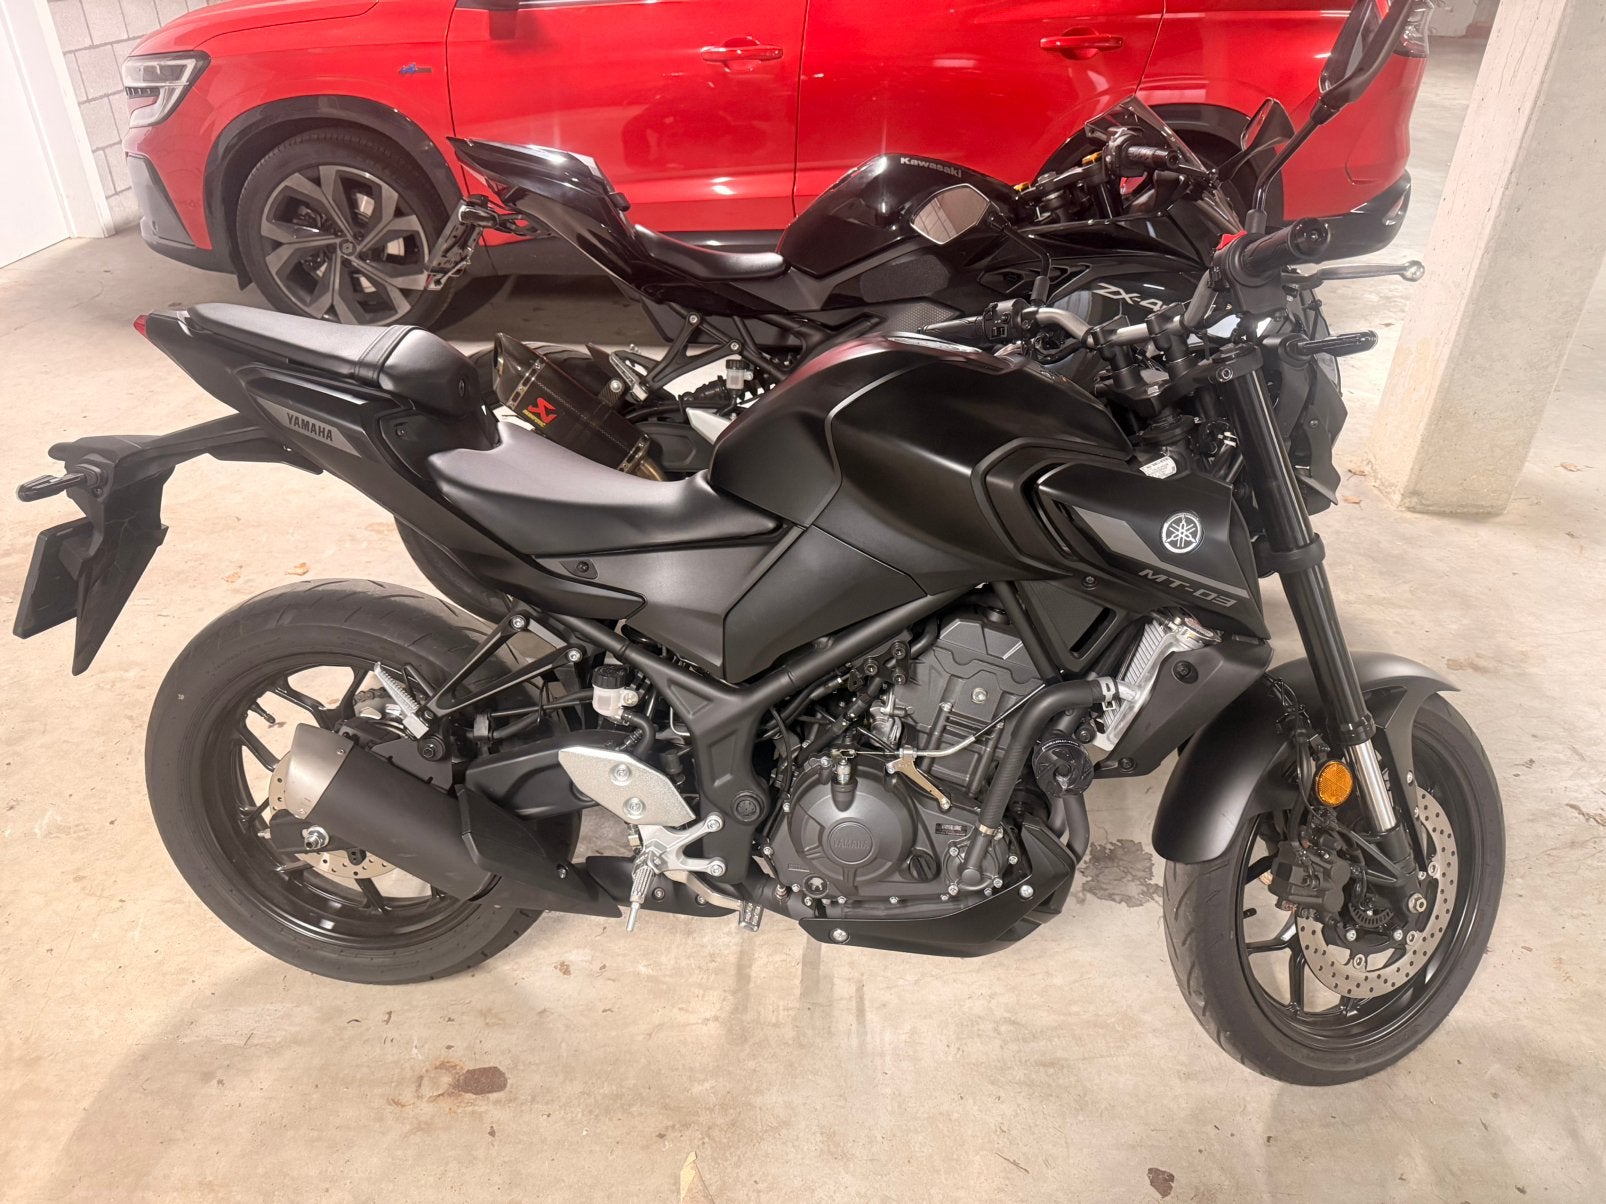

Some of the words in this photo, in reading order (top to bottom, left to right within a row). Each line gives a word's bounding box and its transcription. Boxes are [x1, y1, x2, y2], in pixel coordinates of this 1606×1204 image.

[900, 157, 962, 178] Kawasaki
[1092, 282, 1168, 312] ZX-4
[286, 412, 333, 442] YAMAHA
[1138, 568, 1238, 608] MT-03
[833, 837, 870, 850] YAMAHA
